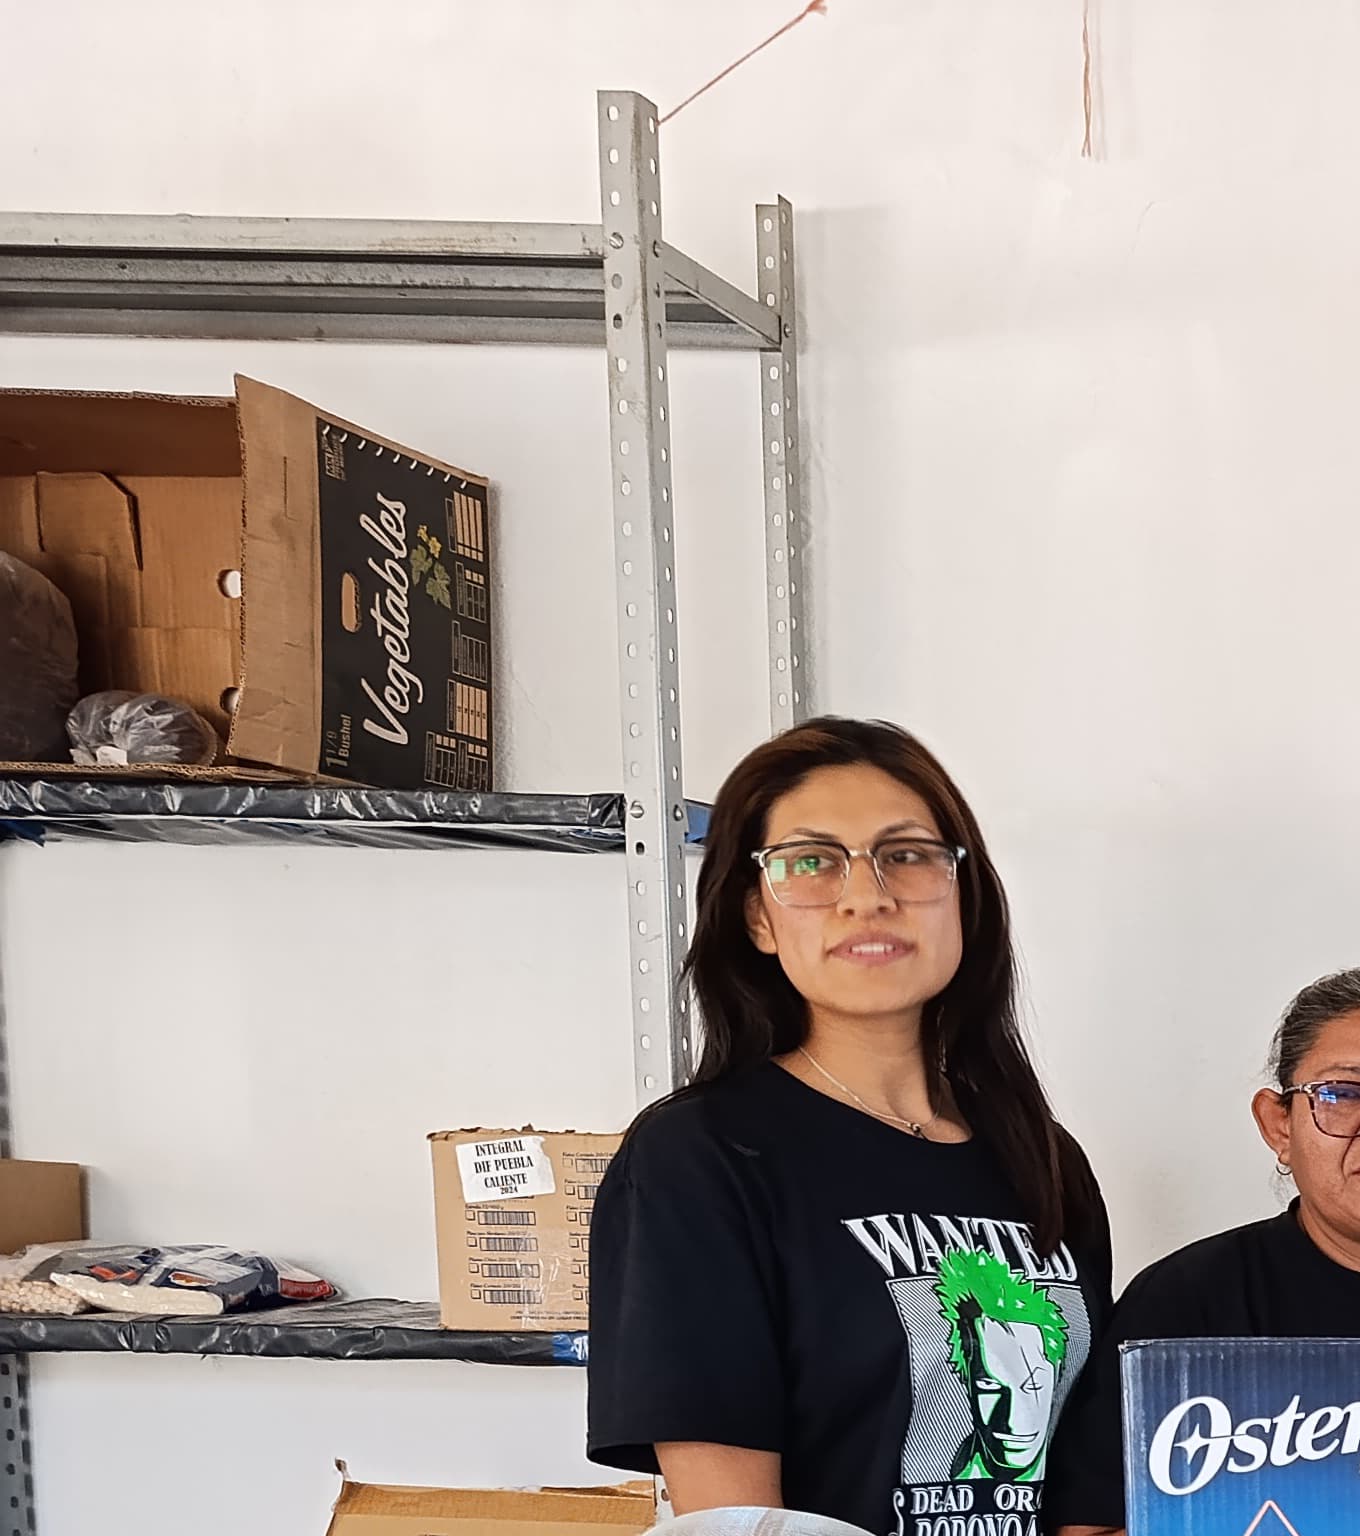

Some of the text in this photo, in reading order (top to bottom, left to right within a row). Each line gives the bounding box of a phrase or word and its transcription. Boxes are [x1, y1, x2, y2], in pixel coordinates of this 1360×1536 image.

[359, 492, 424, 746] Vegetables
[475, 1139, 526, 1157] INTEGRAL
[474, 1156, 534, 1174] DIF PUEBLA
[484, 1172, 529, 1189] CALIENTE
[500, 1185, 519, 1196] 2024
[910, 1482, 1034, 1515] DEAD OR
